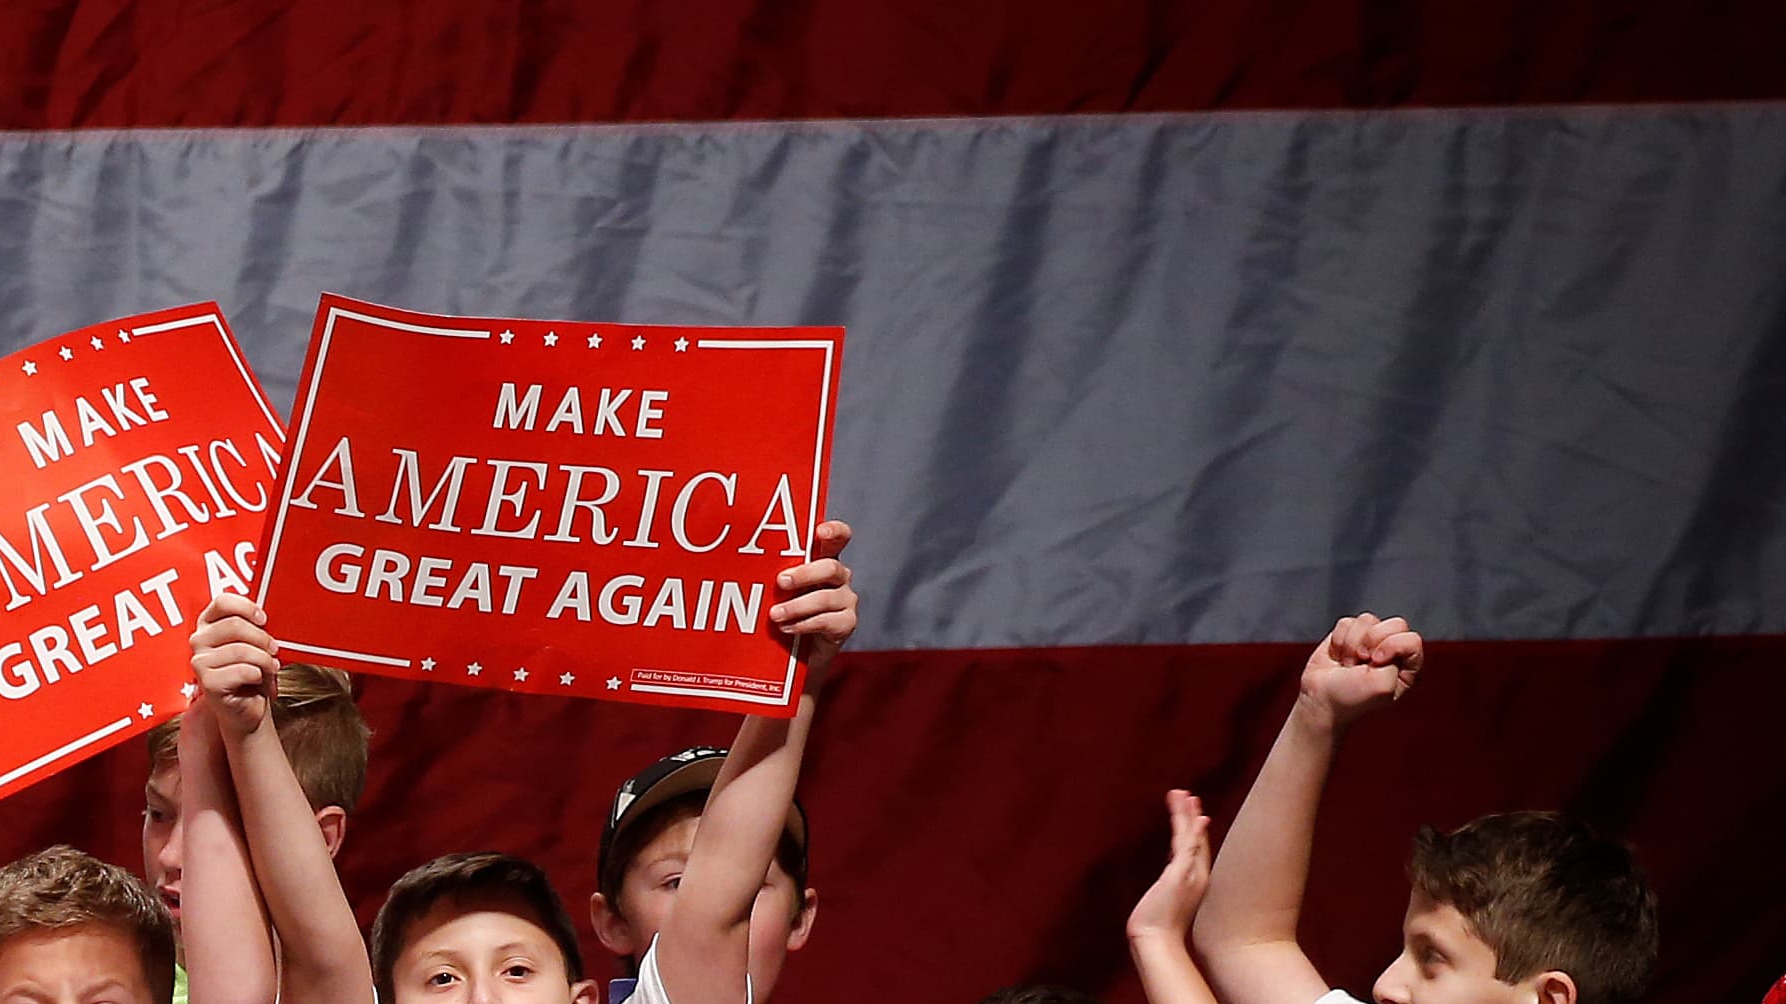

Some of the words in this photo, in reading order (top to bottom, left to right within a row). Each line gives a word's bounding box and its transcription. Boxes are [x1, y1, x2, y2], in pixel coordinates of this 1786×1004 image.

[16, 376, 170, 469] MAKE
[493, 382, 670, 439] MAKE
[290, 436, 806, 557] AMERICA
[315, 543, 538, 615] GREAT
[546, 570, 765, 635] AGAIN
